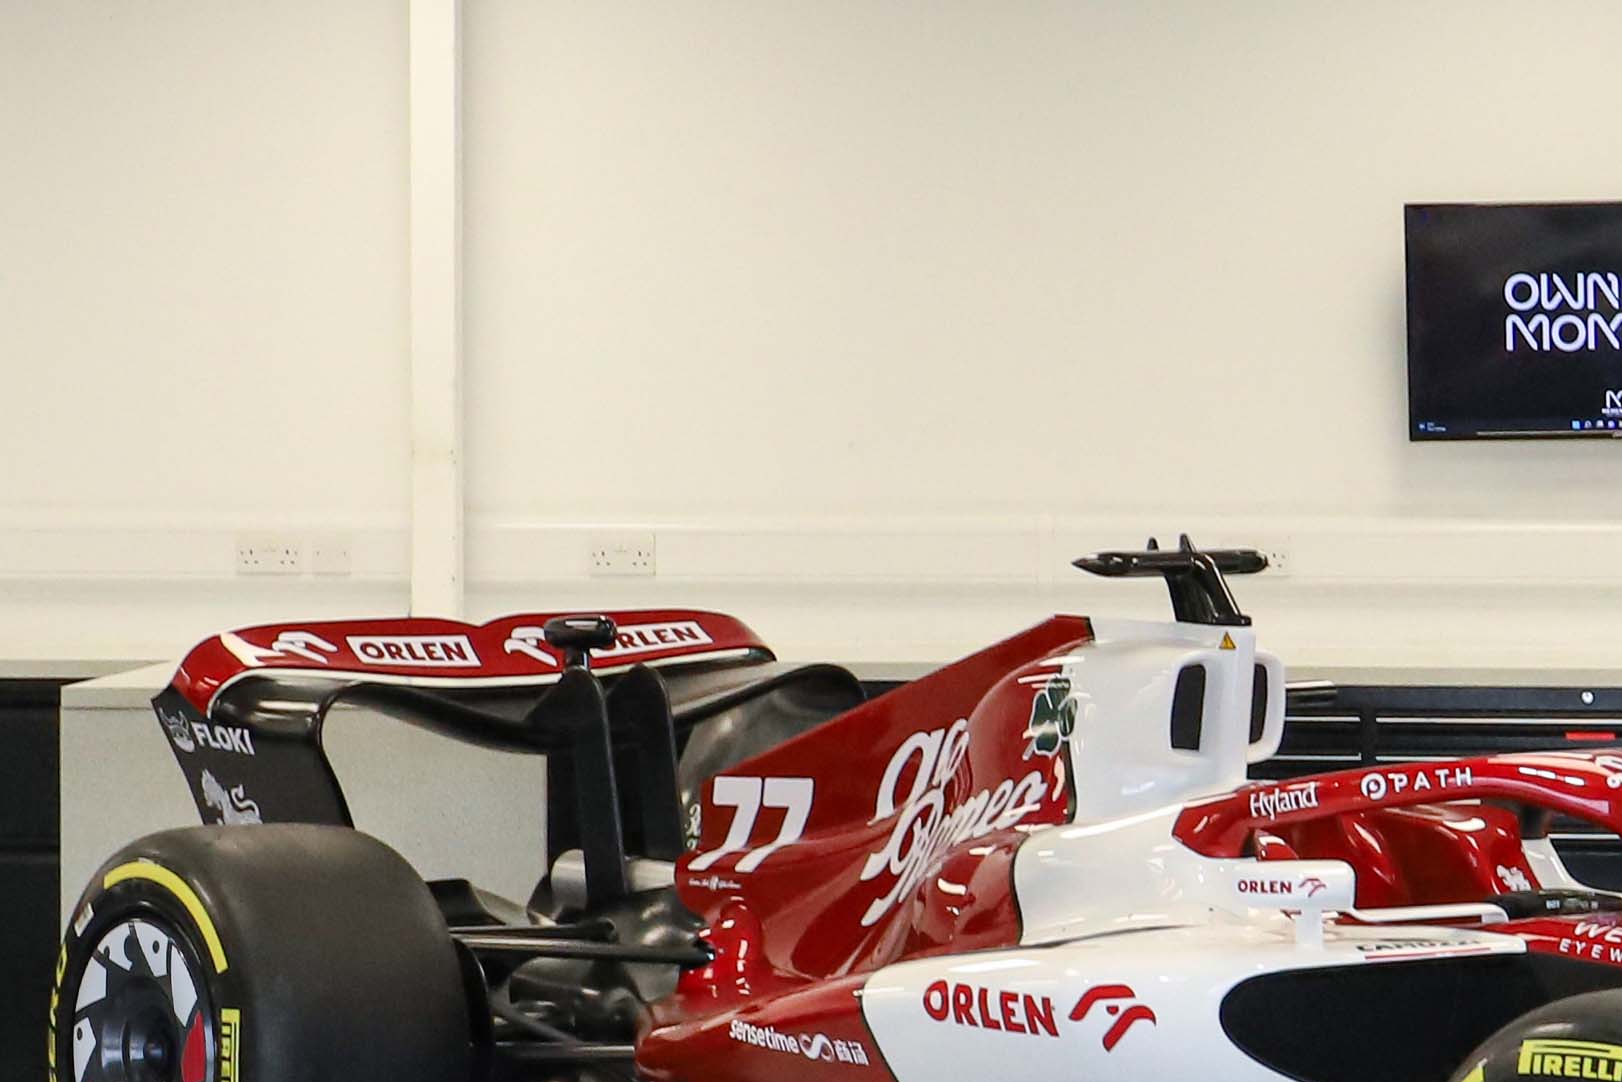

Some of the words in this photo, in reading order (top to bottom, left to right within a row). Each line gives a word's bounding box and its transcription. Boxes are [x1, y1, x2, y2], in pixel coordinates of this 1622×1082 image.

[1504, 272, 1620, 311] OWN
[357, 640, 471, 662] ORLEN
[191, 721, 255, 756] FLOKI
[1250, 782, 1319, 820] Hyland
[687, 776, 814, 873] 77
[1237, 879, 1293, 894] ORLEN
[922, 978, 1060, 1038] ORLEN
[728, 1018, 801, 1054] sensetime
